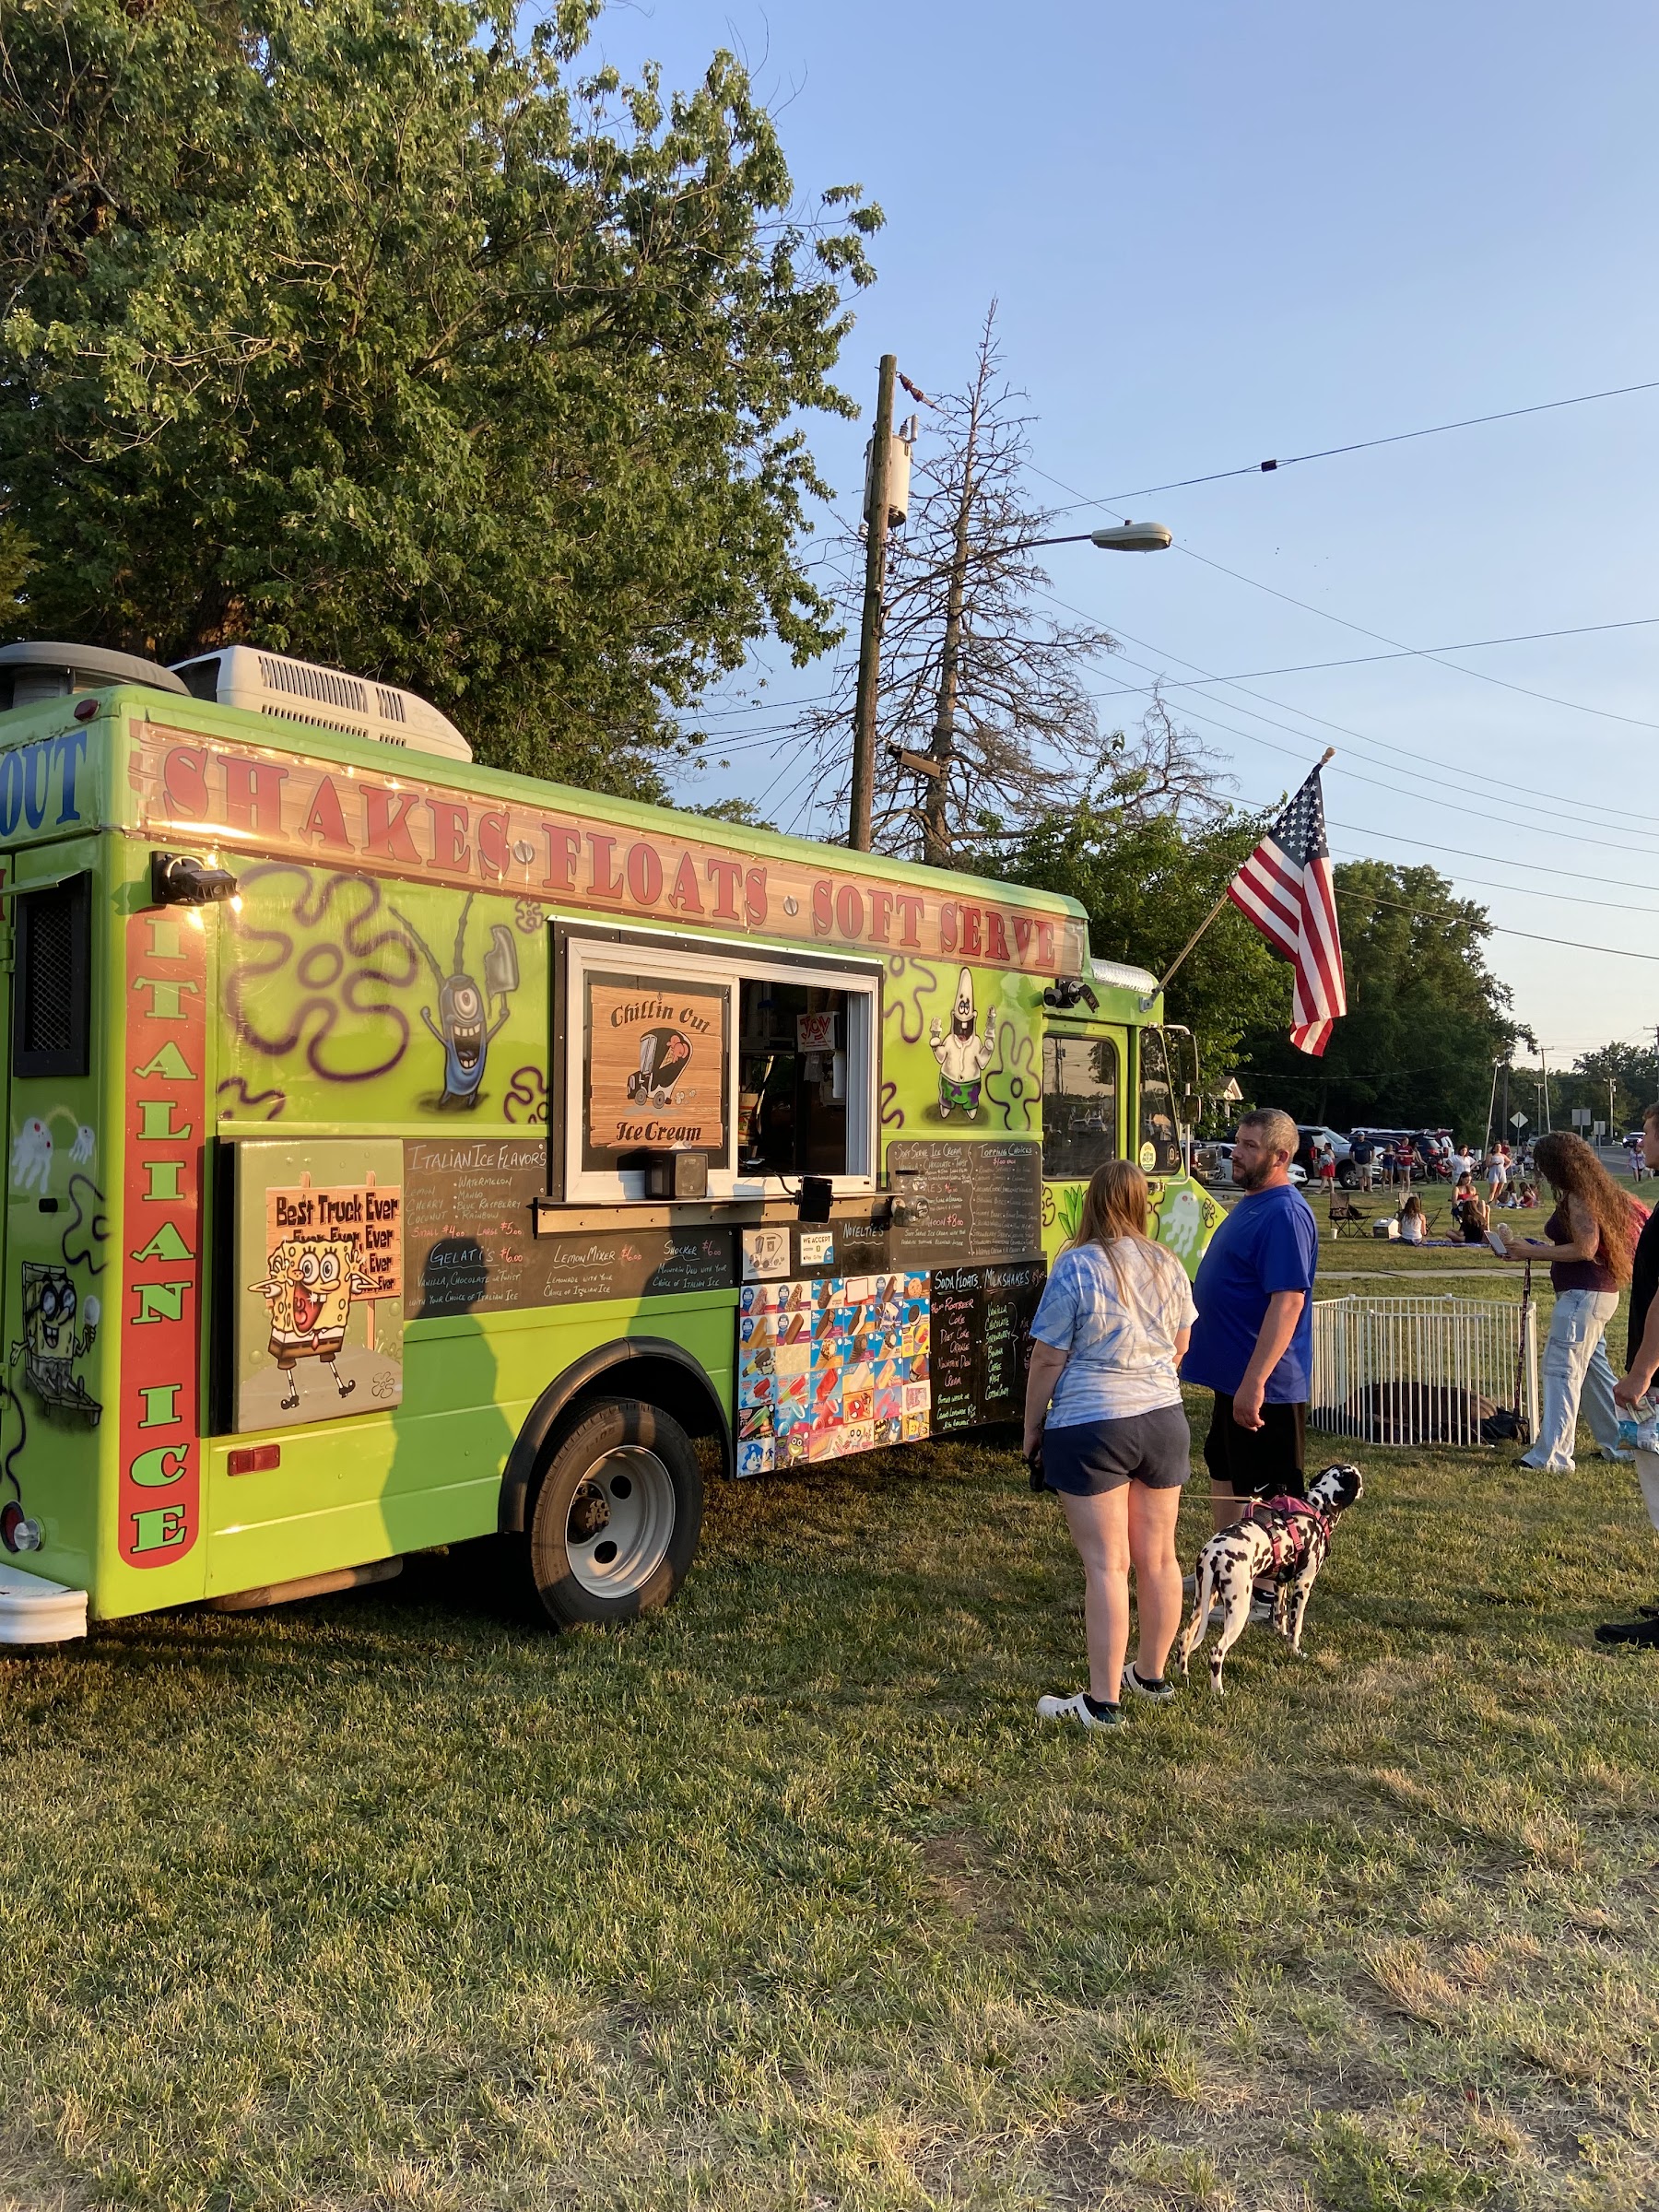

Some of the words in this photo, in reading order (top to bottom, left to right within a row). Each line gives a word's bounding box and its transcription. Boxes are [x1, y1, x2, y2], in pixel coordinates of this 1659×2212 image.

[0, 731, 87, 836] OUT
[163, 746, 512, 882] SHAKES
[542, 823, 768, 926] FLOATS
[813, 879, 924, 948] SOFT
[940, 900, 1055, 967] SERVE
[610, 1000, 674, 1028] Chillin
[800, 1016, 830, 1040] JOY
[131, 918, 199, 1325] ITALIAN
[616, 1122, 642, 1141] Ice
[645, 1121, 702, 1143] Cream
[406, 1144, 471, 1171] ITALIAN
[472, 1144, 495, 1168] ICE
[498, 1145, 547, 1170] FLAVORS
[895, 1144, 911, 1159] SOFT
[911, 1142, 928, 1159] SERVE
[930, 1143, 941, 1157] ICE
[943, 1143, 962, 1156] CREAM
[978, 1144, 1007, 1158] TOPPING
[1008, 1143, 1032, 1156] CHOICES
[924, 1159, 951, 1170] CHOCOLATE
[405, 1182, 435, 1198] LEMON
[458, 1176, 512, 1189] WATERMELON
[457, 1191, 483, 1199] MANGO
[276, 1194, 314, 1227] Best
[318, 1194, 363, 1225] Truck
[366, 1193, 399, 1222] Ever
[406, 1199, 443, 1213] CHERRY
[457, 1202, 475, 1210] BLUE
[479, 1200, 522, 1209] RASPBERRY
[407, 1211, 448, 1226] COCONUT
[462, 1210, 499, 1219] RAINBOW
[366, 1225, 394, 1250] Ever
[411, 1227, 439, 1238] SMALL
[441, 1225, 465, 1239] $4.00
[477, 1223, 498, 1236] LARGE
[500, 1221, 523, 1235] $5.00
[842, 1222, 884, 1239] NOVELTIES
[500, 1246, 523, 1263] $6.00
[554, 1245, 585, 1264] LEMON
[587, 1245, 615, 1262] MIXER
[621, 1245, 642, 1262] $6.00
[663, 1240, 697, 1256] SHOCKER
[701, 1240, 722, 1256] $6.00
[370, 1253, 392, 1273] Ever
[657, 1264, 684, 1274] MOUNTAIN
[685, 1265, 697, 1275] DEW
[714, 1264, 727, 1272] YOUR
[418, 1273, 449, 1288] VANILLA,
[450, 1272, 489, 1286] CHOCOLATE
[547, 1272, 578, 1284] LEMONADE
[598, 1273, 613, 1281] YOUR
[652, 1277, 671, 1287] CHOICE
[683, 1279, 705, 1288] ITALIAN
[707, 1277, 720, 1287] ICE
[935, 1270, 955, 1289] SODA
[955, 1267, 979, 1288] FLOATS
[984, 1268, 1030, 1288] MILKSHAKES
[409, 1297, 426, 1307] WITH
[429, 1295, 443, 1304] YOUR
[445, 1290, 465, 1303] CHOICE
[477, 1292, 503, 1302] ITALIAN
[506, 1289, 519, 1300] ICE
[543, 1285, 561, 1298] CHOICE
[572, 1285, 598, 1296] ITALIAN
[598, 1285, 611, 1294] ICE
[945, 1297, 974, 1311] ROOTBEER
[987, 1301, 1007, 1317] VANILLA
[948, 1312, 966, 1325] COKE
[984, 1317, 1009, 1332] CHOCOLATE
[940, 1329, 954, 1344] DIET
[956, 1327, 970, 1339] COKE
[985, 1330, 1011, 1345] STRAWBERRY
[950, 1341, 970, 1353] ORANGE
[987, 1346, 1004, 1359] BANANA
[937, 1357, 959, 1370] MOUNTAIN
[960, 1355, 971, 1369] DEW
[987, 1359, 1002, 1372] COFFEE
[945, 1370, 961, 1387] CREAM
[989, 1373, 1002, 1384] MALT
[130, 1383, 190, 1554] ICE
